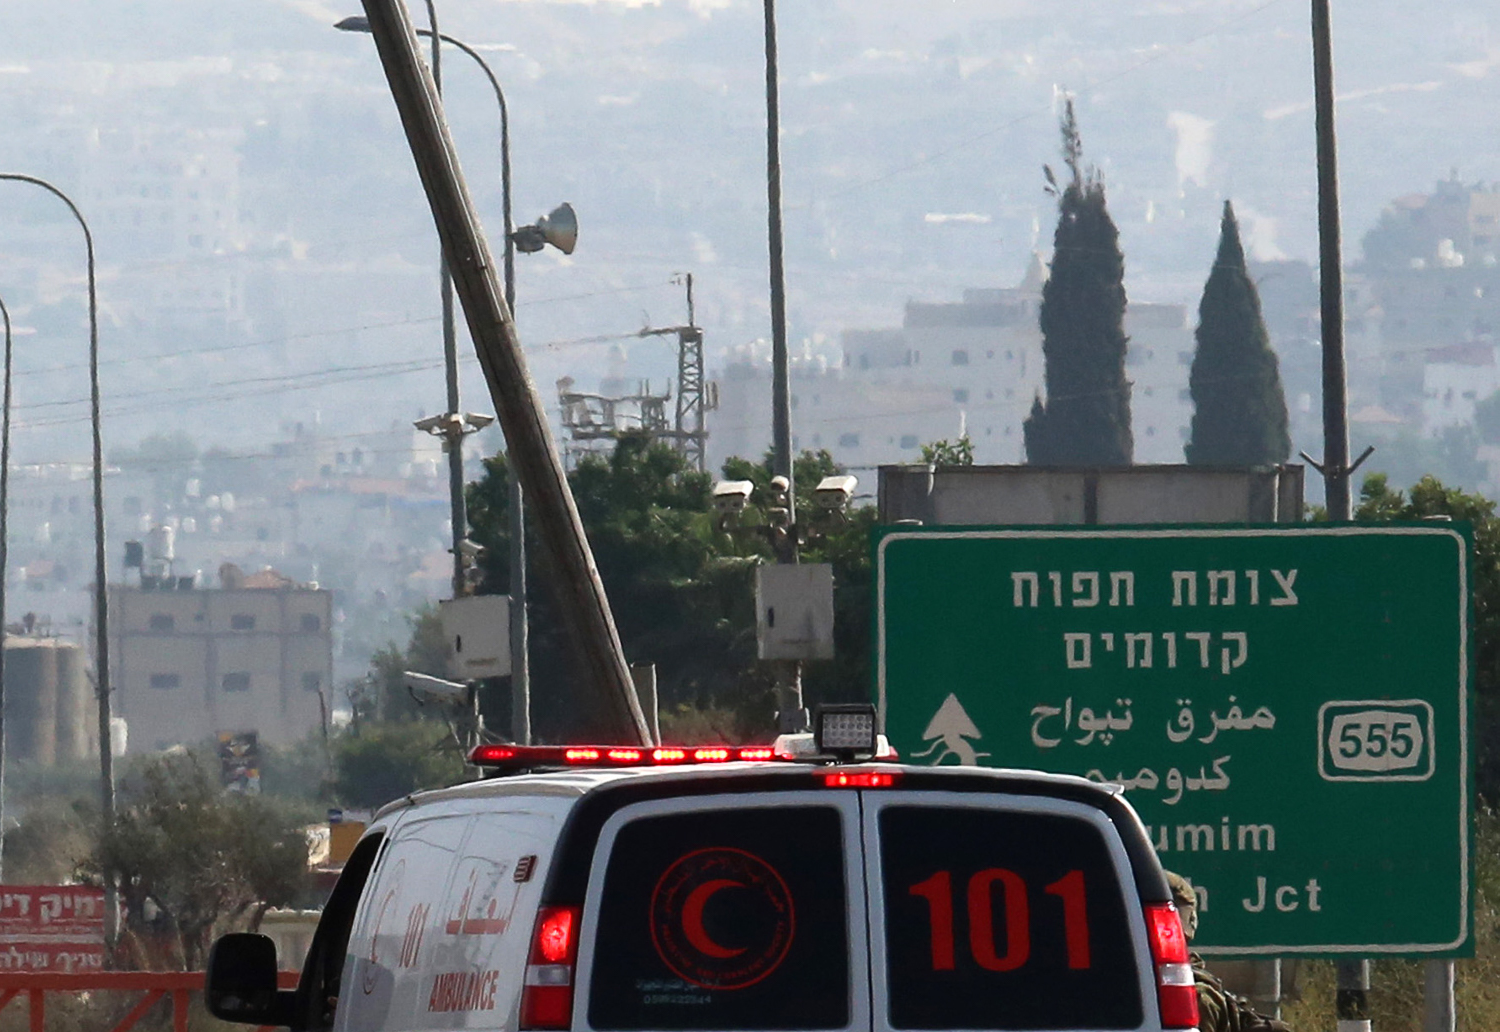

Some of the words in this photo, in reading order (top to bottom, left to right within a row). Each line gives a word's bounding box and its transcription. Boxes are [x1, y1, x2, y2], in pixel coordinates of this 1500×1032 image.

[1010, 570, 1136, 608] תפוח
[1171, 568, 1299, 608] צומת
[1063, 631, 1249, 675] קדומים
[1166, 694, 1277, 744] مفرق
[1338, 722, 1414, 759] 555
[1148, 816, 1276, 852] umim
[1242, 876, 1322, 913] Jct
[909, 867, 1091, 970] 101
[427, 970, 500, 1013] AMBULANCE
